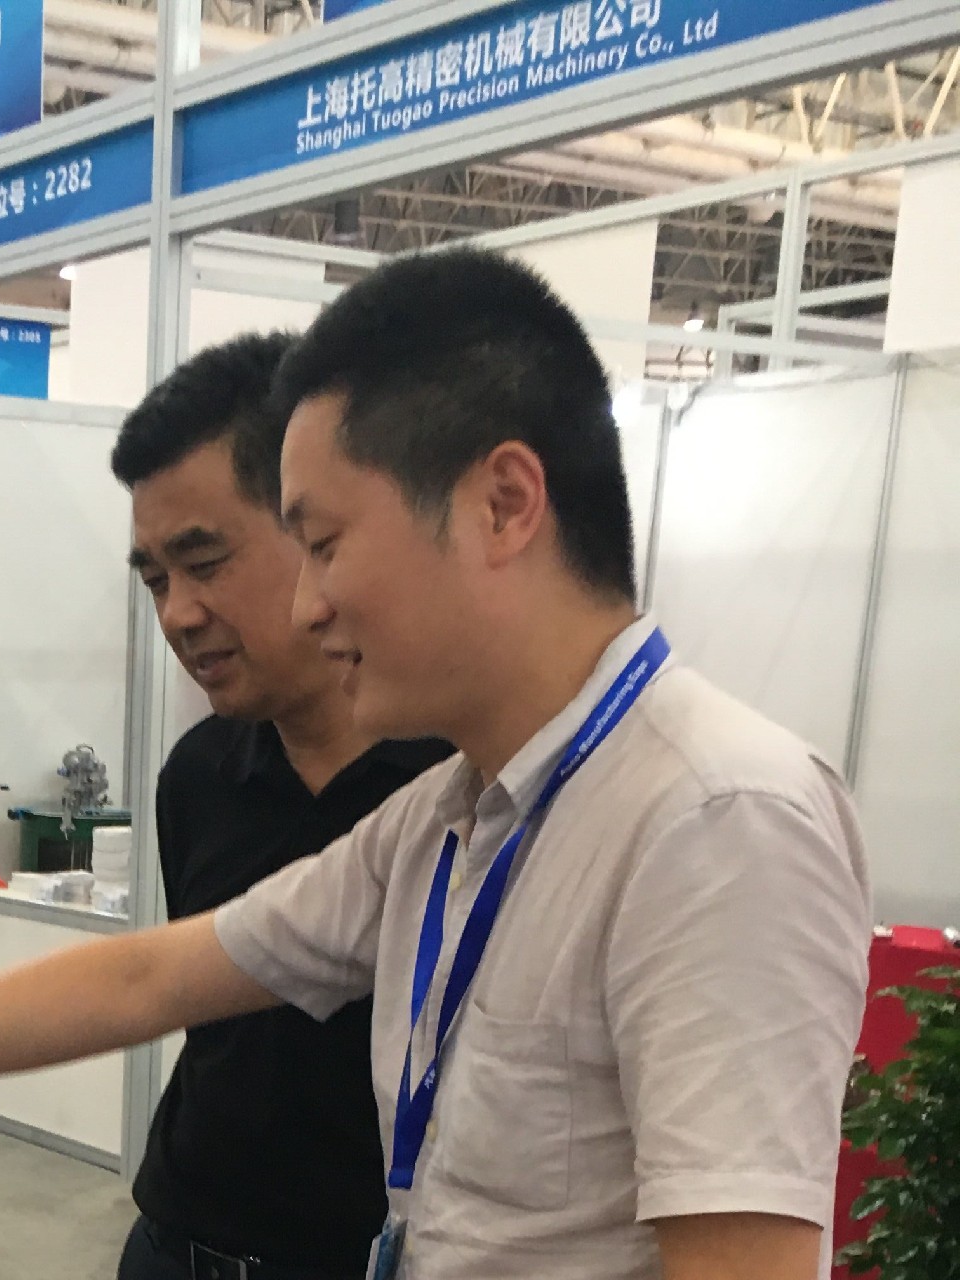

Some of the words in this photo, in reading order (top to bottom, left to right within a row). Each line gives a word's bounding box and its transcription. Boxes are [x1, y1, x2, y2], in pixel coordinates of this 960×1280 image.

[297, 115, 366, 154] Shanghai
[372, 100, 433, 132] Tuogao
[439, 74, 519, 114] Precision
[526, 42, 629, 90] Machinery
[683, 10, 719, 46] Ltd
[298, 0, 662, 129] 上海托高精密机械有限公司
